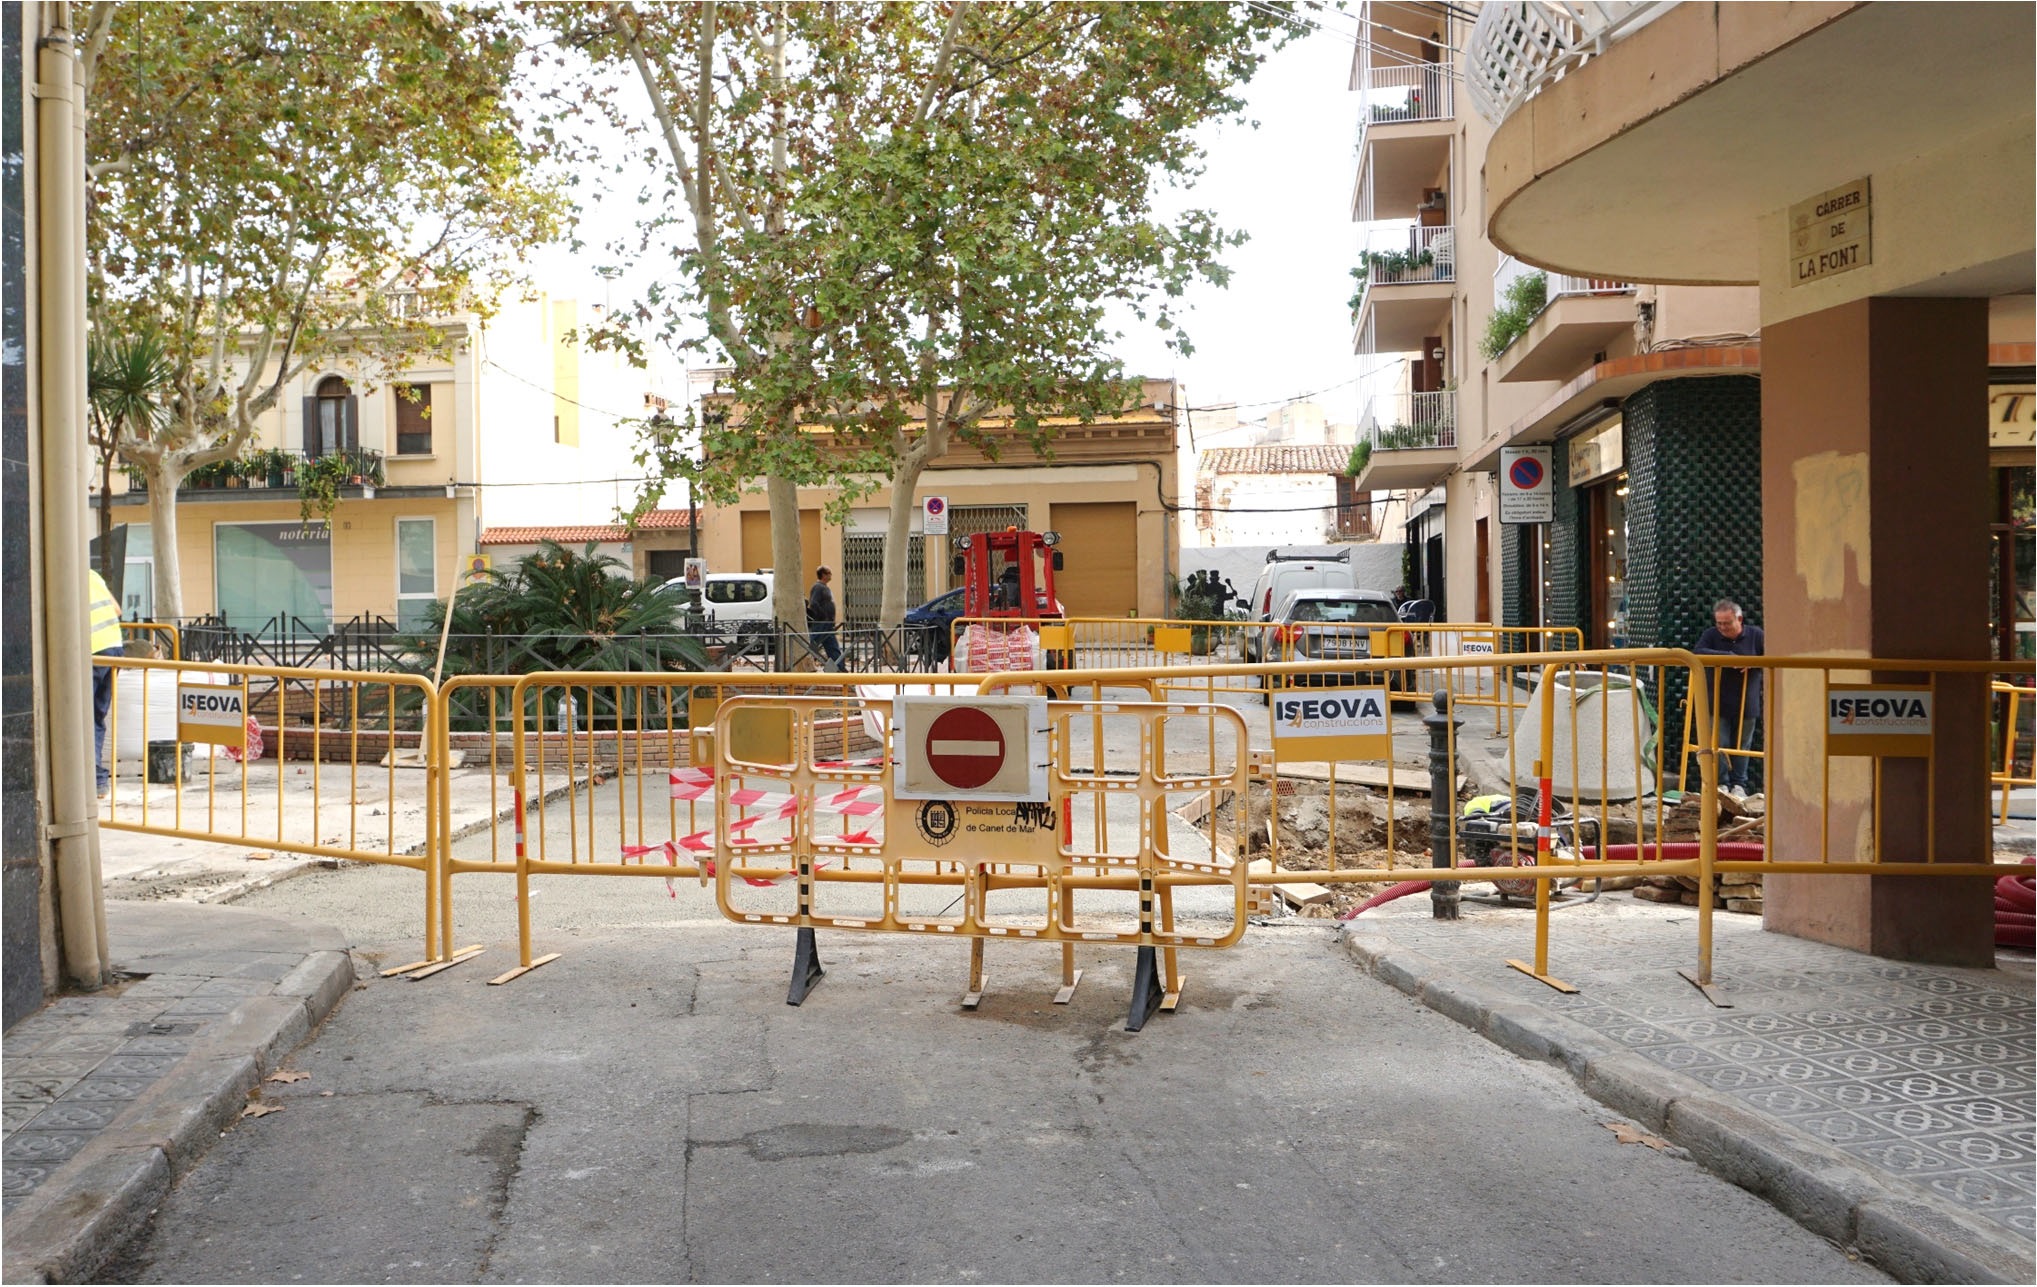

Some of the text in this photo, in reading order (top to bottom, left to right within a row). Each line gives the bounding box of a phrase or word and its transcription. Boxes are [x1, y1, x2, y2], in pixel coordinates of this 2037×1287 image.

[1816, 191, 1860, 217] CARRER
[1831, 222, 1846, 238] DE
[1799, 244, 1859, 279] LA FONT
[182, 694, 242, 713] ISEOVA
[1276, 698, 1382, 721] ISEOVA
[1831, 698, 1927, 718] ISEOVA
[1303, 717, 1384, 729] construccions
[996, 807, 1017, 816] Loca
[966, 824, 1035, 833] de Canet de Mar
